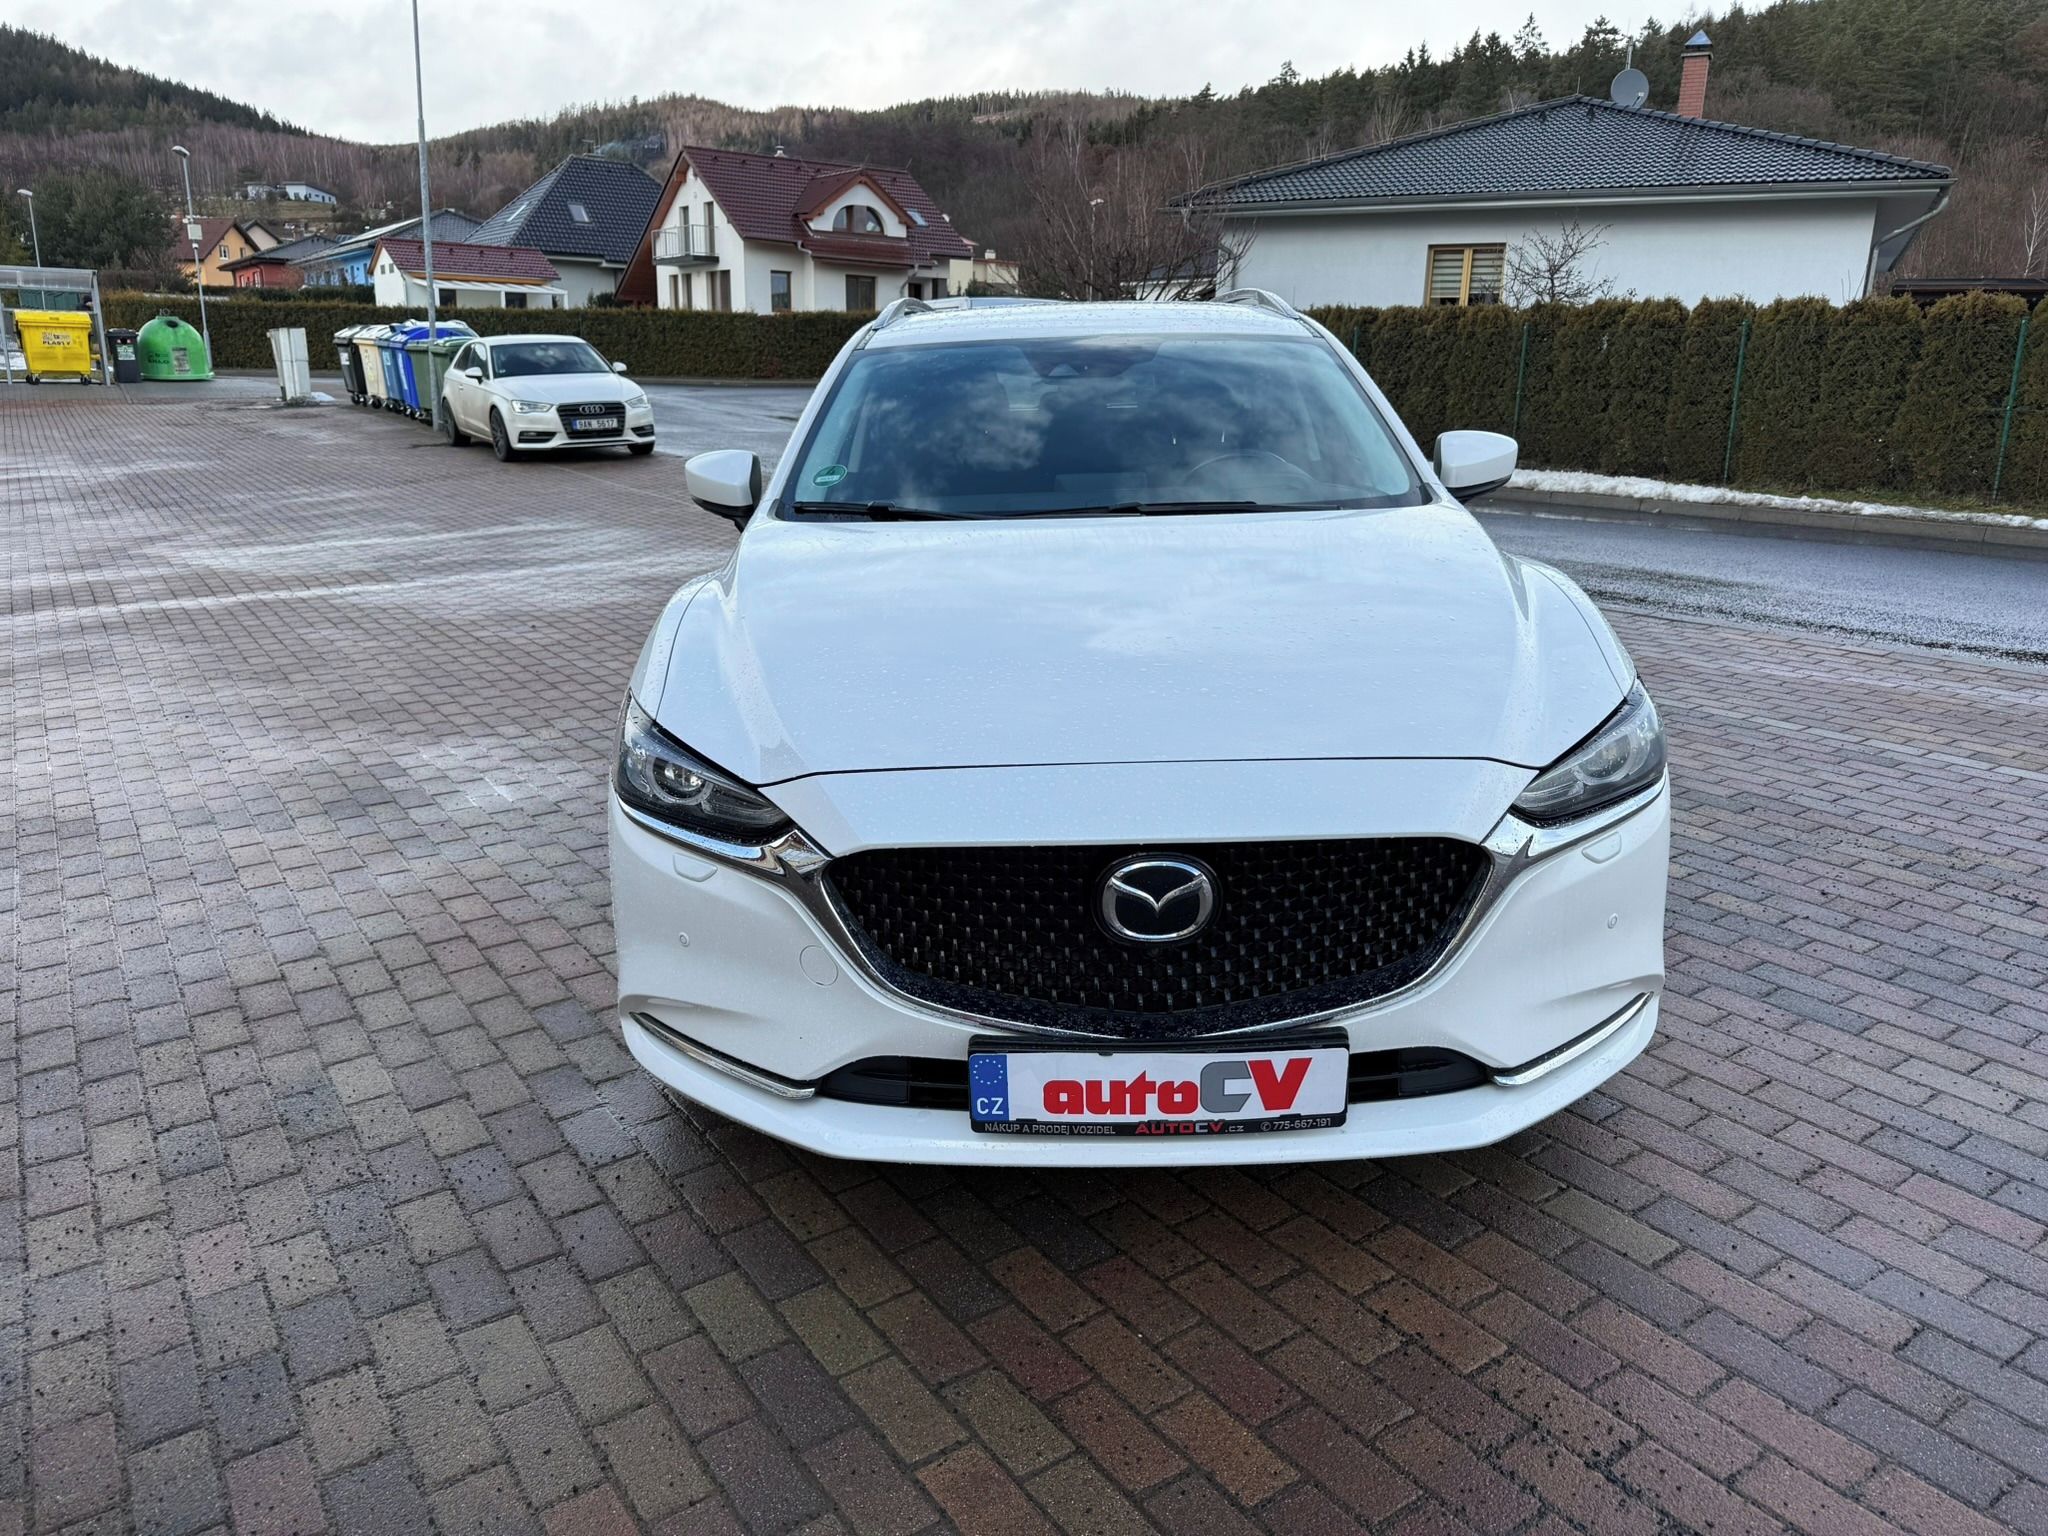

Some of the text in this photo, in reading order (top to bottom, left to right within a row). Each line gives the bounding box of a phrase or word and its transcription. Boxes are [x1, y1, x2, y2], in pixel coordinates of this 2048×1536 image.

[1043, 1057, 1313, 1115] autoCV
[976, 1098, 1004, 1115] CZ
[984, 1121, 1116, 1135] NÁKUP A PRODEJ VOZIDEL
[1272, 1117, 1331, 1130] 775-667-191
